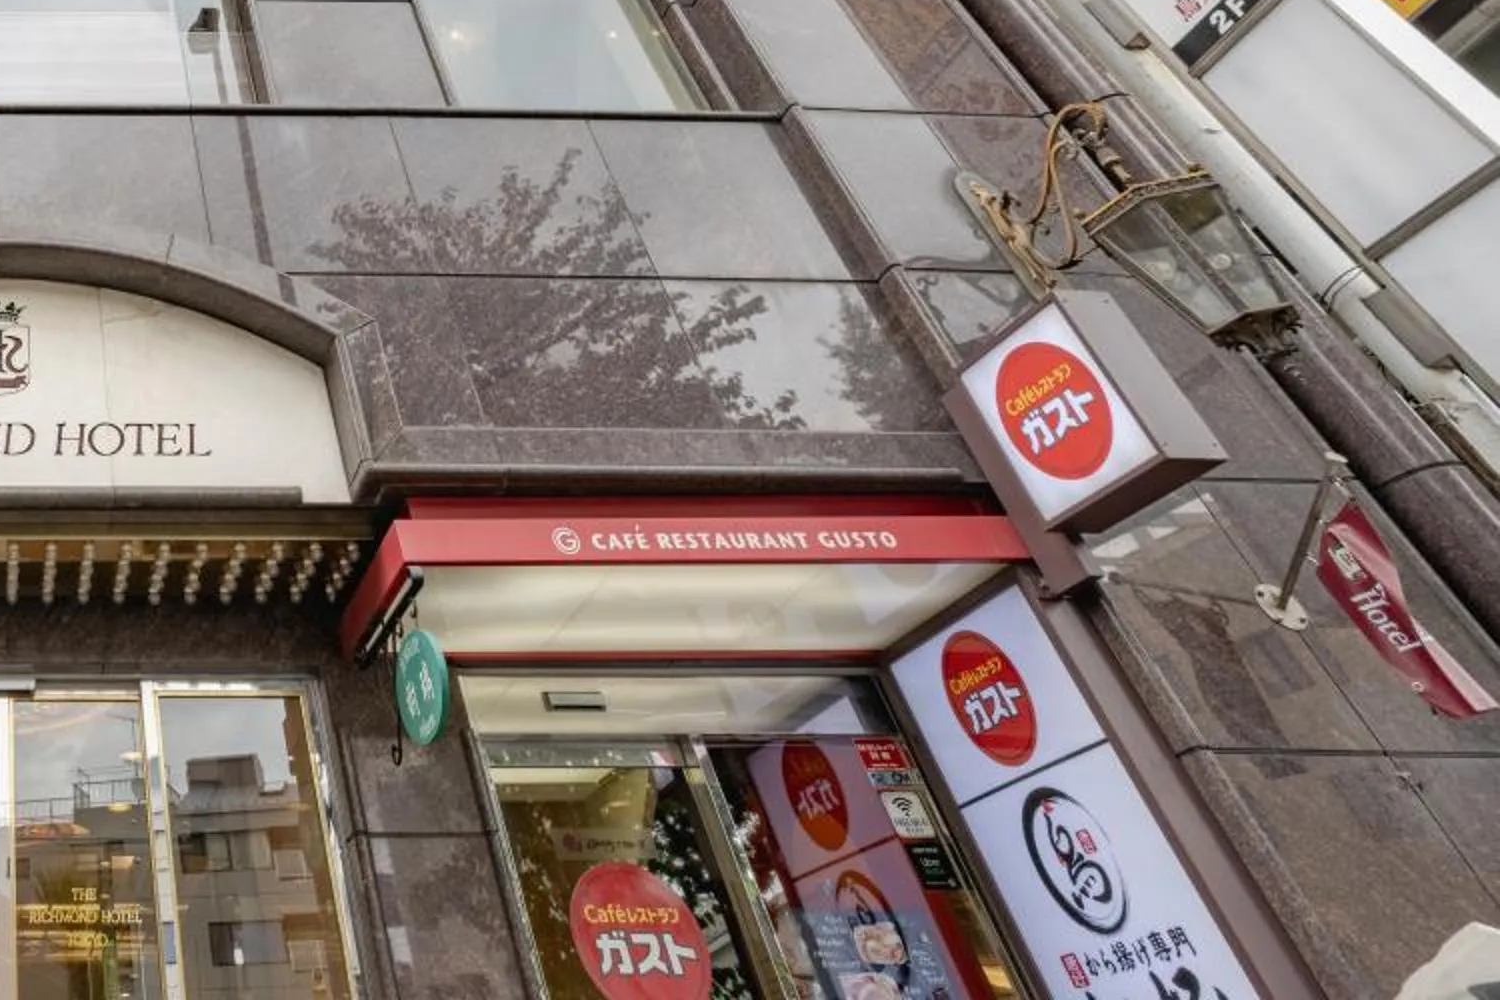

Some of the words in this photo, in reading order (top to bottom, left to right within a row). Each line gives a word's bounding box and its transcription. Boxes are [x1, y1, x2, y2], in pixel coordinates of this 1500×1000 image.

[53, 421, 213, 457] HOTEL
[1020, 388, 1094, 455] ガスト
[591, 524, 649, 550] CAFÉ
[656, 532, 809, 550] RESTAURANT
[818, 531, 898, 549] GUSTO
[1351, 582, 1423, 654] Hotel
[964, 680, 1021, 735] ガスト
[71, 888, 97, 901] THE
[29, 910, 99, 924] RICHMOND
[101, 909, 142, 925] HOTEL
[595, 930, 697, 976] ガスト
